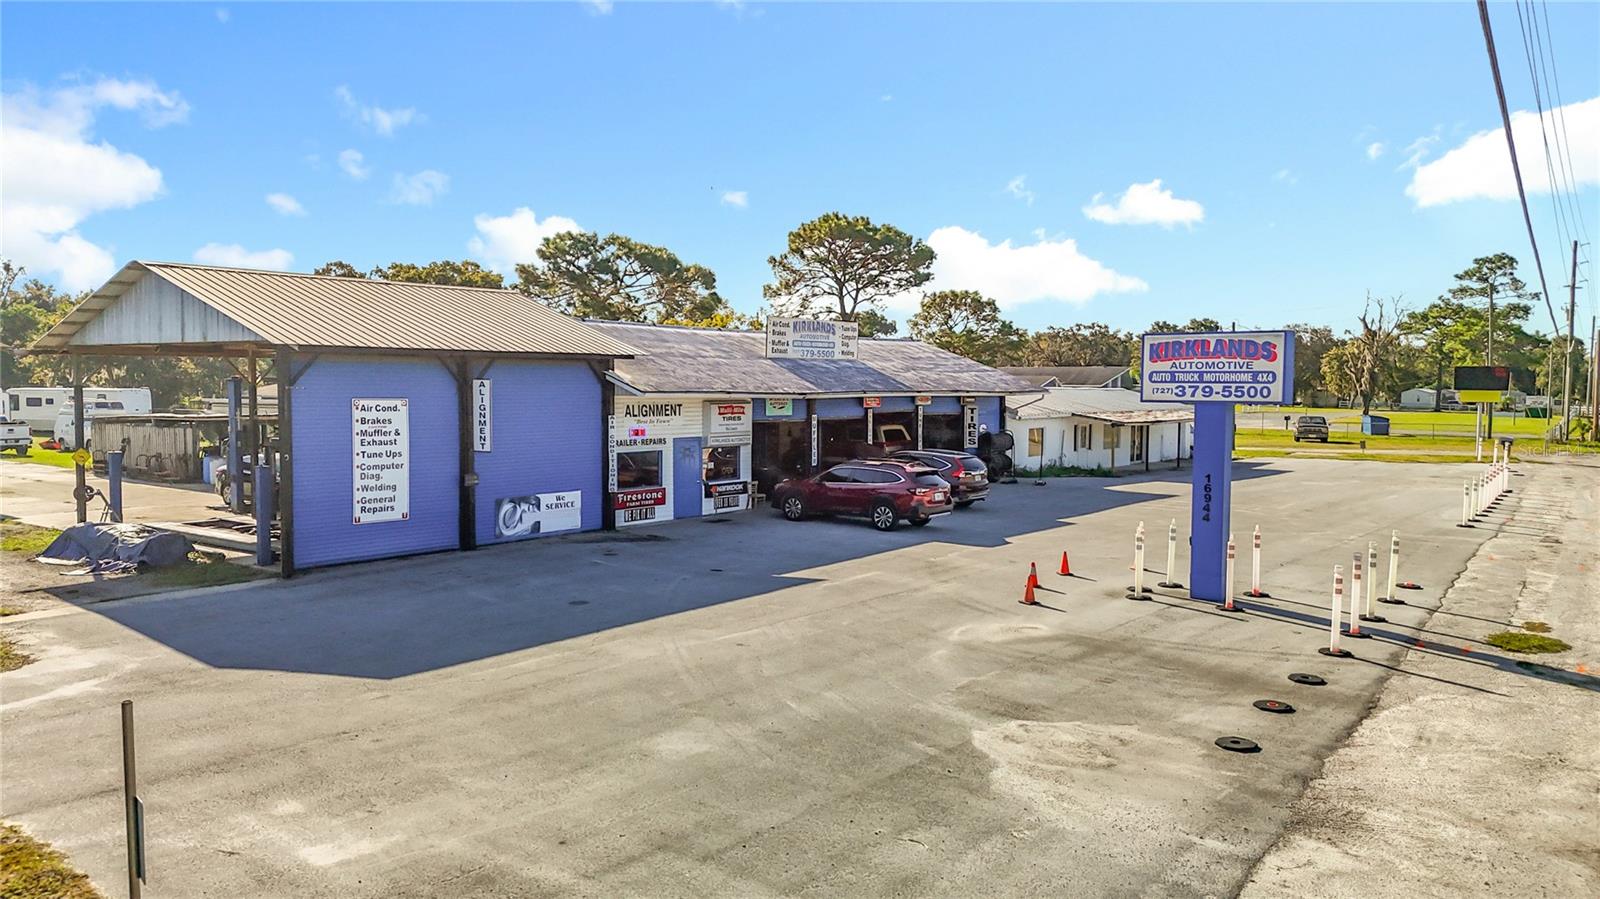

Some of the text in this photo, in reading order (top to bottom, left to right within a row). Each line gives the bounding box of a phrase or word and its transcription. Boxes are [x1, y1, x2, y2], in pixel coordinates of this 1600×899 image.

[792, 320, 836, 336] KIRKLANDS
[1149, 339, 1278, 362] KIRKLANDS
[1170, 361, 1254, 369] AUTOMOTIVE
[1152, 373, 1272, 381] AUTO TRUCK MOTORHOME 4X4
[1174, 385, 1271, 398] 379-5500
[625, 404, 682, 417] ALIGNMENT
[360, 417, 392, 425] Brakes
[968, 408, 976, 445] TIRES
[360, 429, 392, 437] Muffler
[360, 438, 397, 446] Exhaust
[385, 450, 402, 459] Ups
[360, 463, 404, 471] Computer
[360, 472, 383, 481] Diag.
[361, 484, 396, 492] Welding
[361, 495, 396, 504] General
[618, 492, 662, 504] Firestone
[1202, 474, 1212, 522] 16944
[361, 505, 395, 514] Repairs
[545, 501, 575, 510] SERVICE
